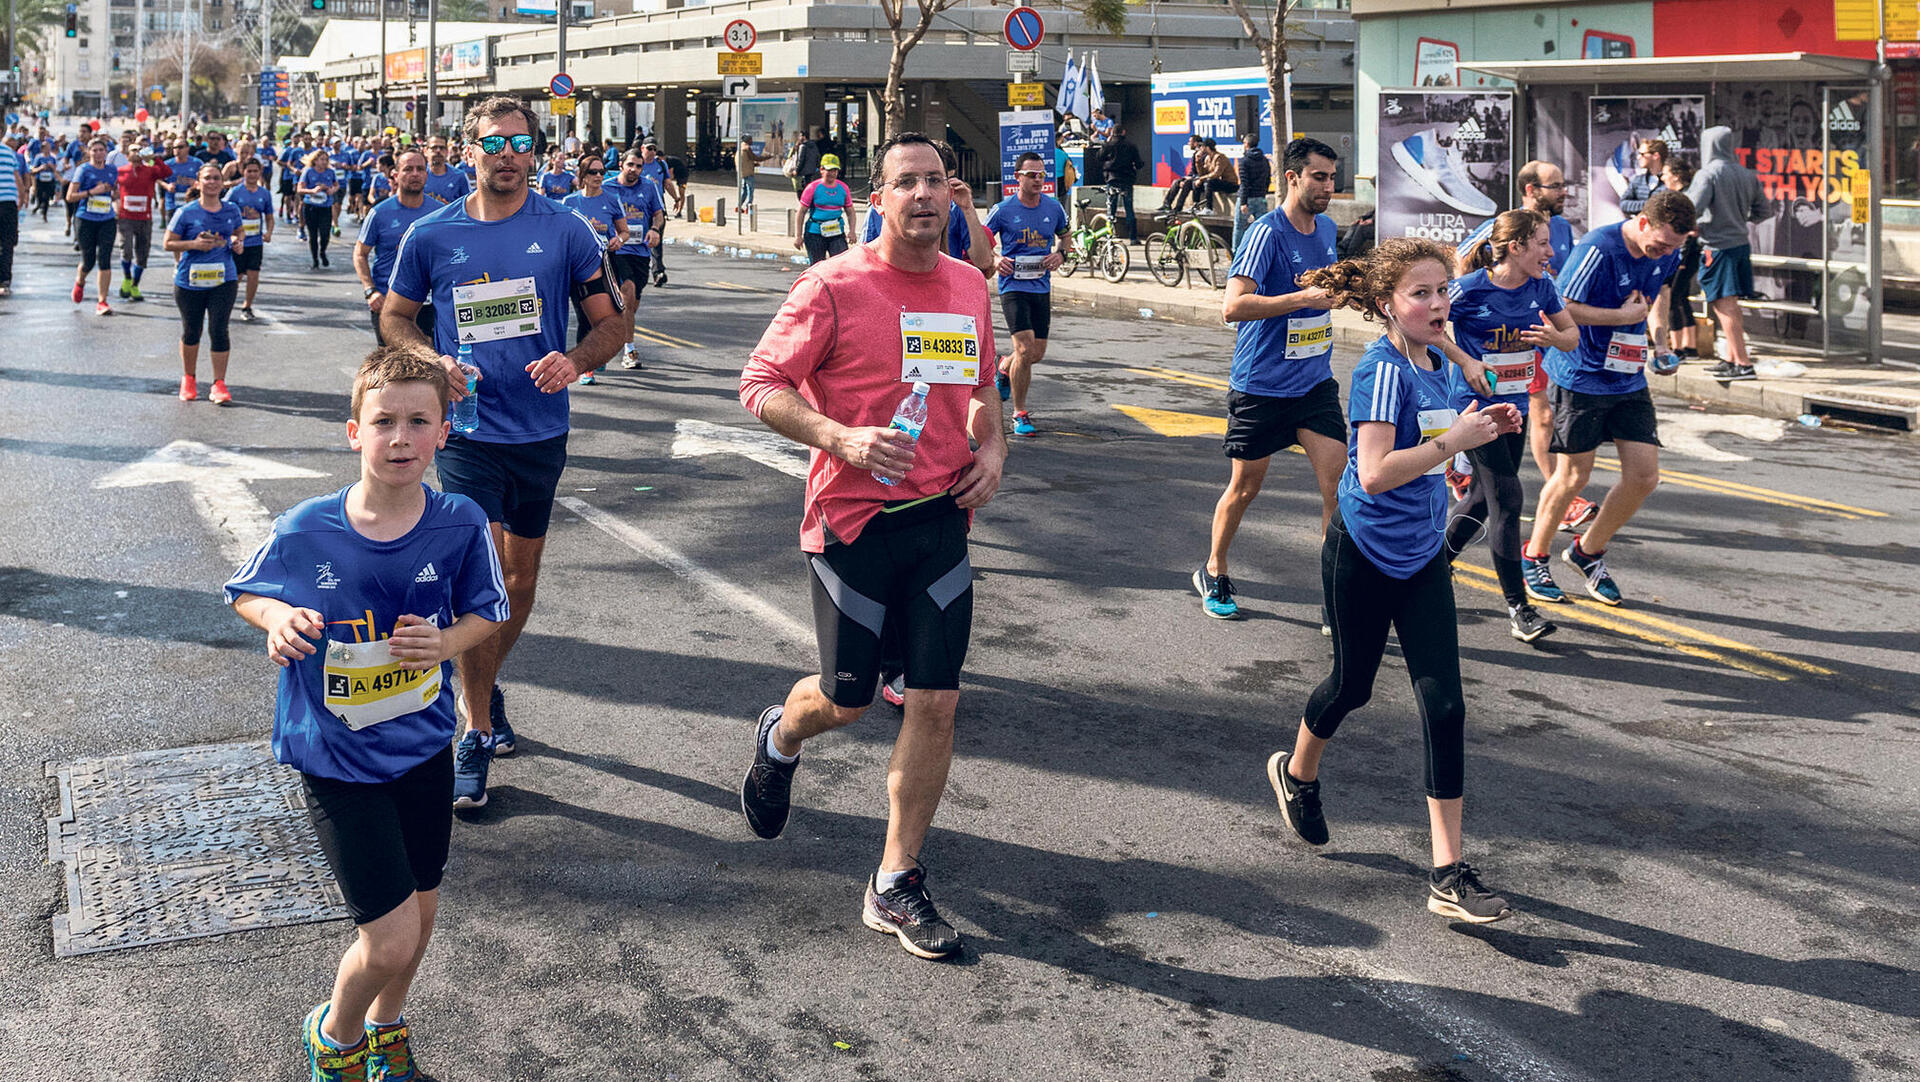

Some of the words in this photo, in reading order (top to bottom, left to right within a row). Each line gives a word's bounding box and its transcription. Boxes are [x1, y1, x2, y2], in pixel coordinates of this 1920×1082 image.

[731, 30, 749, 41] 3.1
[1197, 97, 1233, 120] בקצב
[1756, 147, 1860, 177] STARTS
[1757, 174, 1798, 202] TH
[1419, 213, 1466, 229] ULTRA
[1404, 227, 1465, 243] BOOST
[485, 302, 517, 318] 32082
[923, 340, 931, 350] B
[932, 339, 963, 354] 43833
[415, 574, 439, 584] adidas
[353, 680, 367, 693] A
[372, 670, 418, 693] 49712
